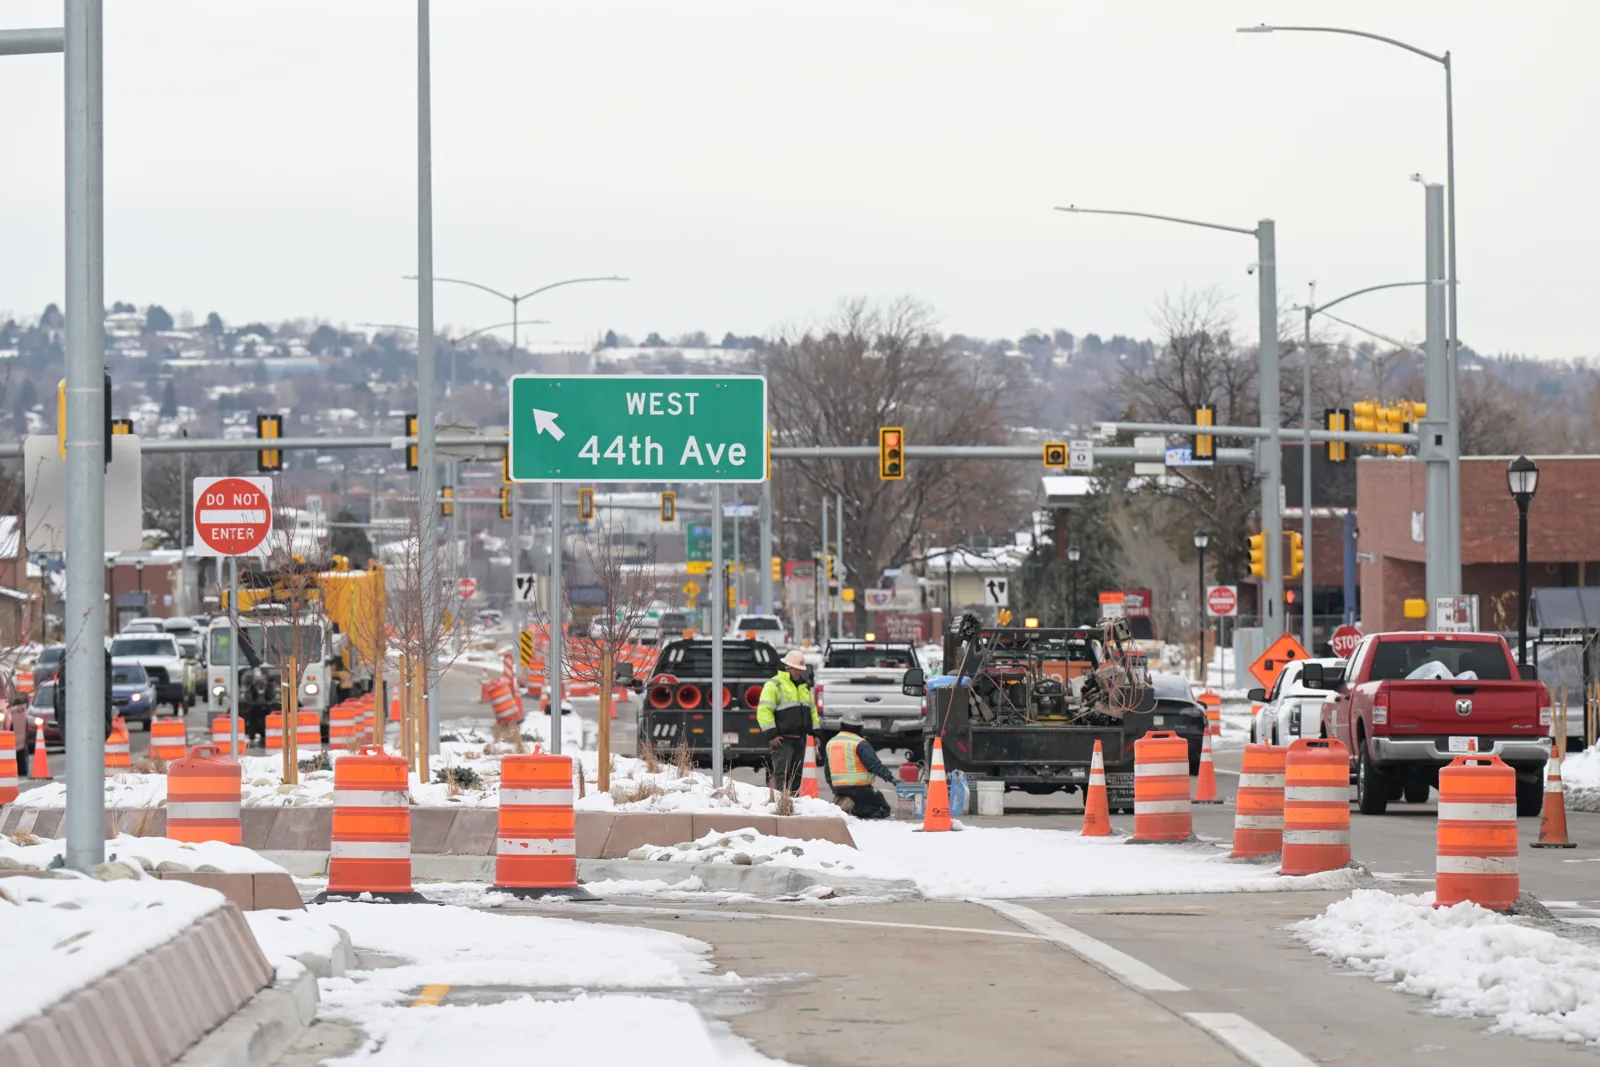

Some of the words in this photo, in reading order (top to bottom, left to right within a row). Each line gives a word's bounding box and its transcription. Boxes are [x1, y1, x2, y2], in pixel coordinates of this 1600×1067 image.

[626, 392, 699, 415] WEST
[578, 435, 663, 466] 44th
[679, 435, 746, 466] Ave
[206, 493, 225, 506] DO
[233, 493, 260, 506] NOT
[211, 527, 255, 540] ENTER
[1334, 634, 1362, 651] STOP
